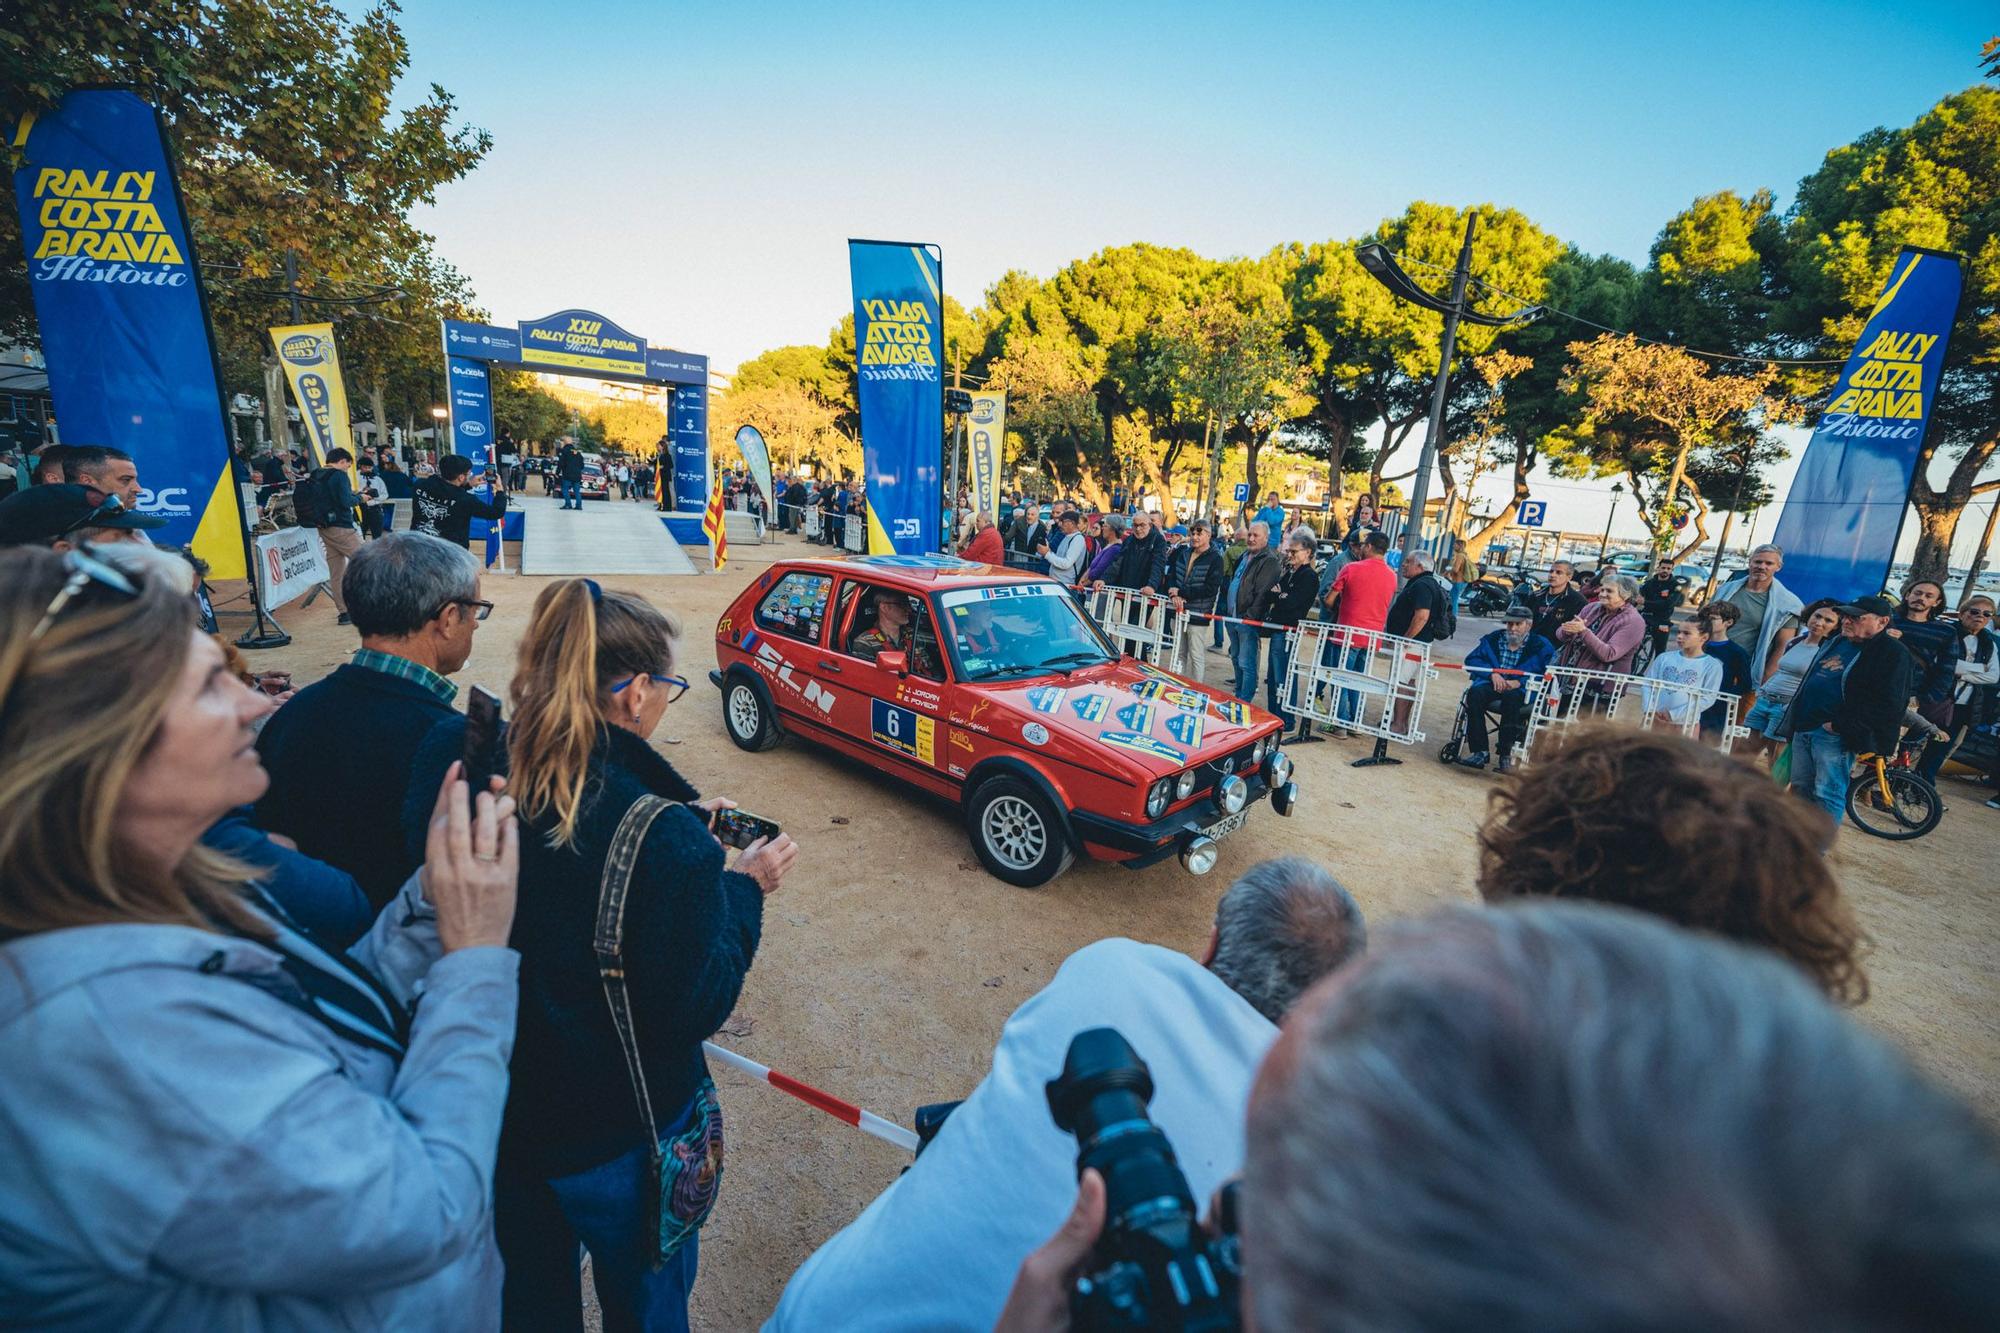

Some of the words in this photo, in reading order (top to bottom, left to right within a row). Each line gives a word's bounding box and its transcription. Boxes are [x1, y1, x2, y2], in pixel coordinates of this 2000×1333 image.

[33, 168, 156, 201] RALLY
[39, 199, 167, 233] COSTA
[33, 230, 185, 265] BRAVA
[35, 254, 189, 287] Històric
[530, 328, 565, 342] RALLY
[565, 333, 599, 347] COSTA
[601, 338, 638, 352] BRAVA
[567, 318, 602, 335] XXII
[1858, 330, 1939, 361] RALLY
[1848, 360, 1923, 391] COSTA
[1824, 388, 1923, 420] BRAVA
[1237, 485, 1246, 499] P
[1522, 503, 1541, 523] P
[994, 586, 1043, 598] SLN
[887, 709, 900, 737] 6
